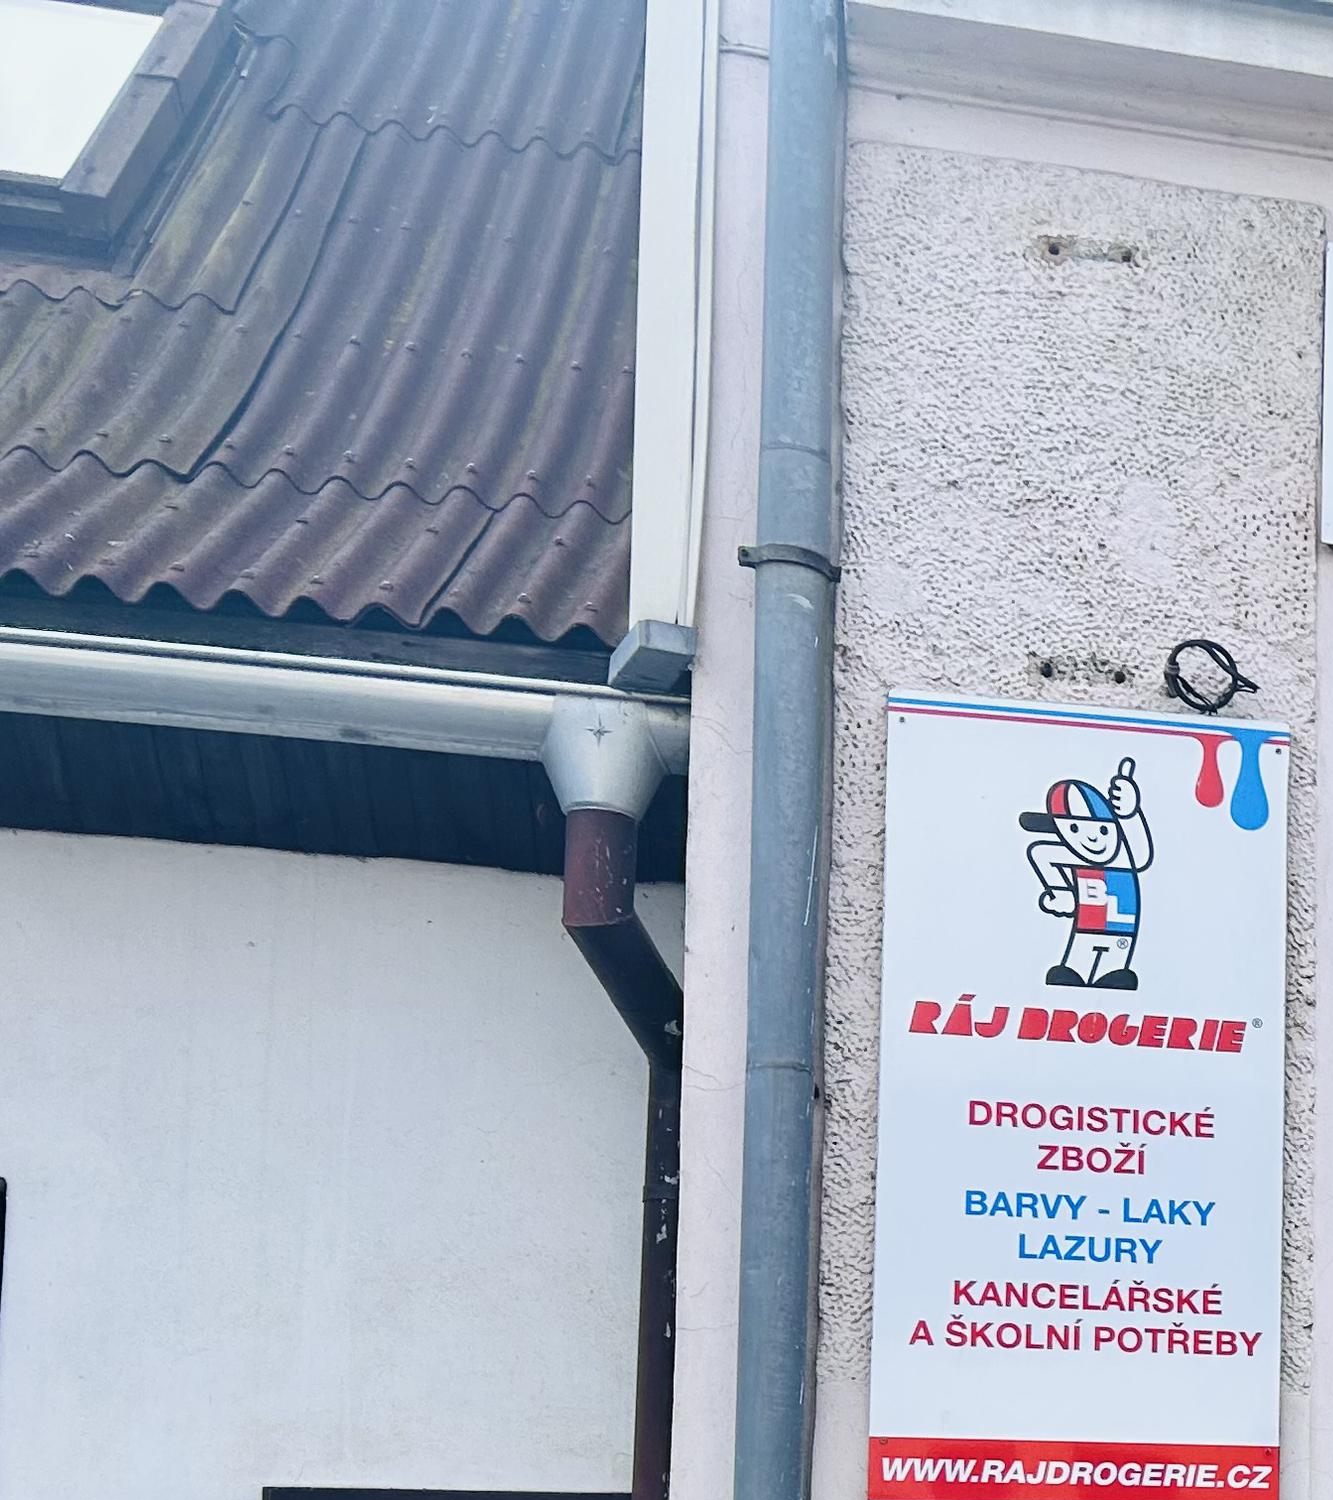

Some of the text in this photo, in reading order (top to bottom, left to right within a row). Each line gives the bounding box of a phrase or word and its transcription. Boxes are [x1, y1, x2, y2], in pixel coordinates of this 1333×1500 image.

[909, 994, 1247, 1053] RÁJ DROGERIE
[968, 1101, 1215, 1139] DROGISTICKÉ
[1037, 1142, 1146, 1175] ZBOŽÍ
[965, 1190, 1087, 1220] BARVY
[1122, 1198, 1216, 1226] LAKY
[1018, 1234, 1163, 1264] LAZURY
[953, 1280, 1223, 1315] KANCELÁŘSKÉ
[909, 1314, 1263, 1356] A ŠKOLNÍ POTŘEBY
[882, 1457, 1272, 1489] WWW.RAJDROGERIE.CZ
